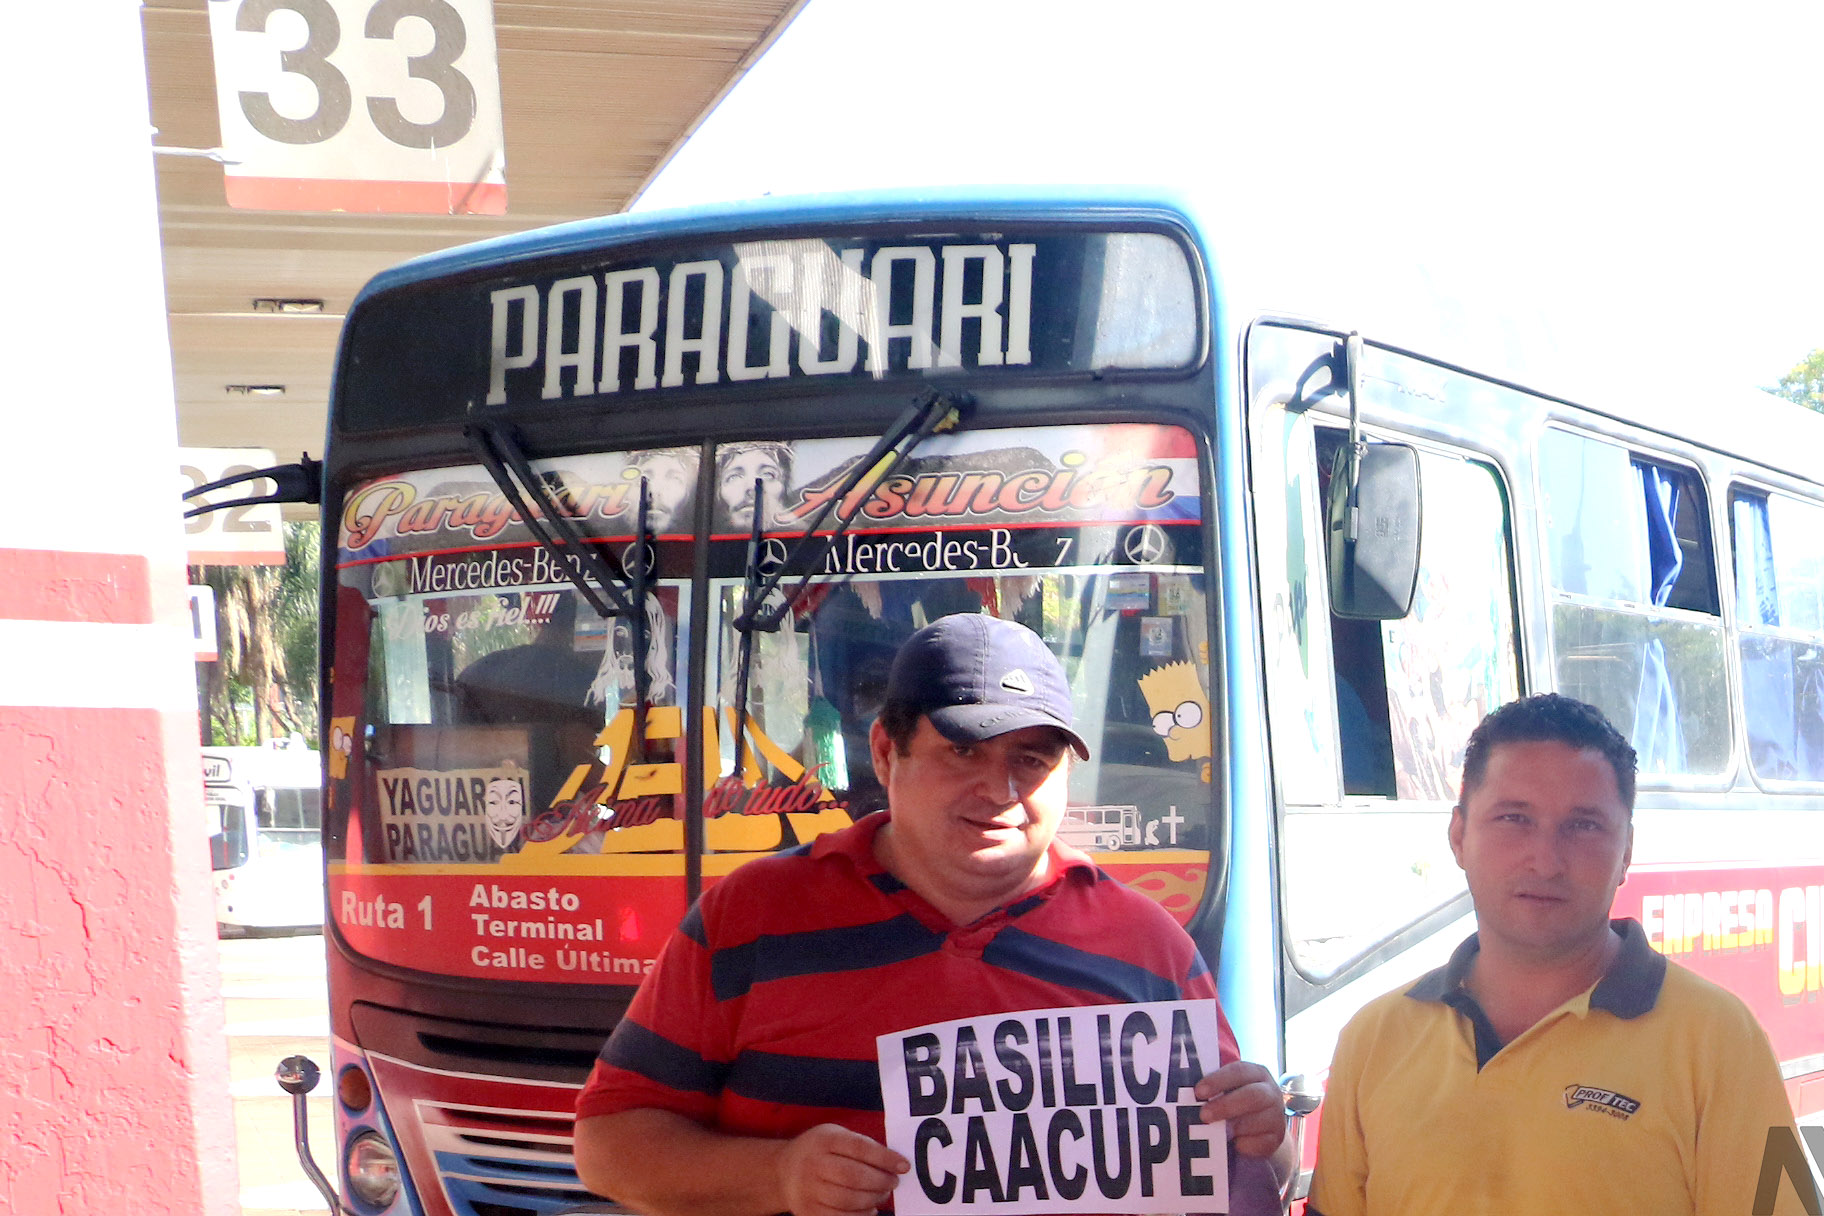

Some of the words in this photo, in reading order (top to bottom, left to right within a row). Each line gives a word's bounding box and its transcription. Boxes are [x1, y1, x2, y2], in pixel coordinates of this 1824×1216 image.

[235, 0, 477, 148] 33
[486, 243, 1038, 406] PARAGUARI
[457, 610, 481, 630] es
[341, 889, 405, 930] Ruta
[417, 895, 433, 931] 1
[469, 883, 580, 911] Abasto
[471, 913, 603, 941] Terminal
[470, 945, 545, 970] Calle
[902, 1009, 1209, 1117] BASILICA
[914, 1105, 1214, 1205] CAACUPE
